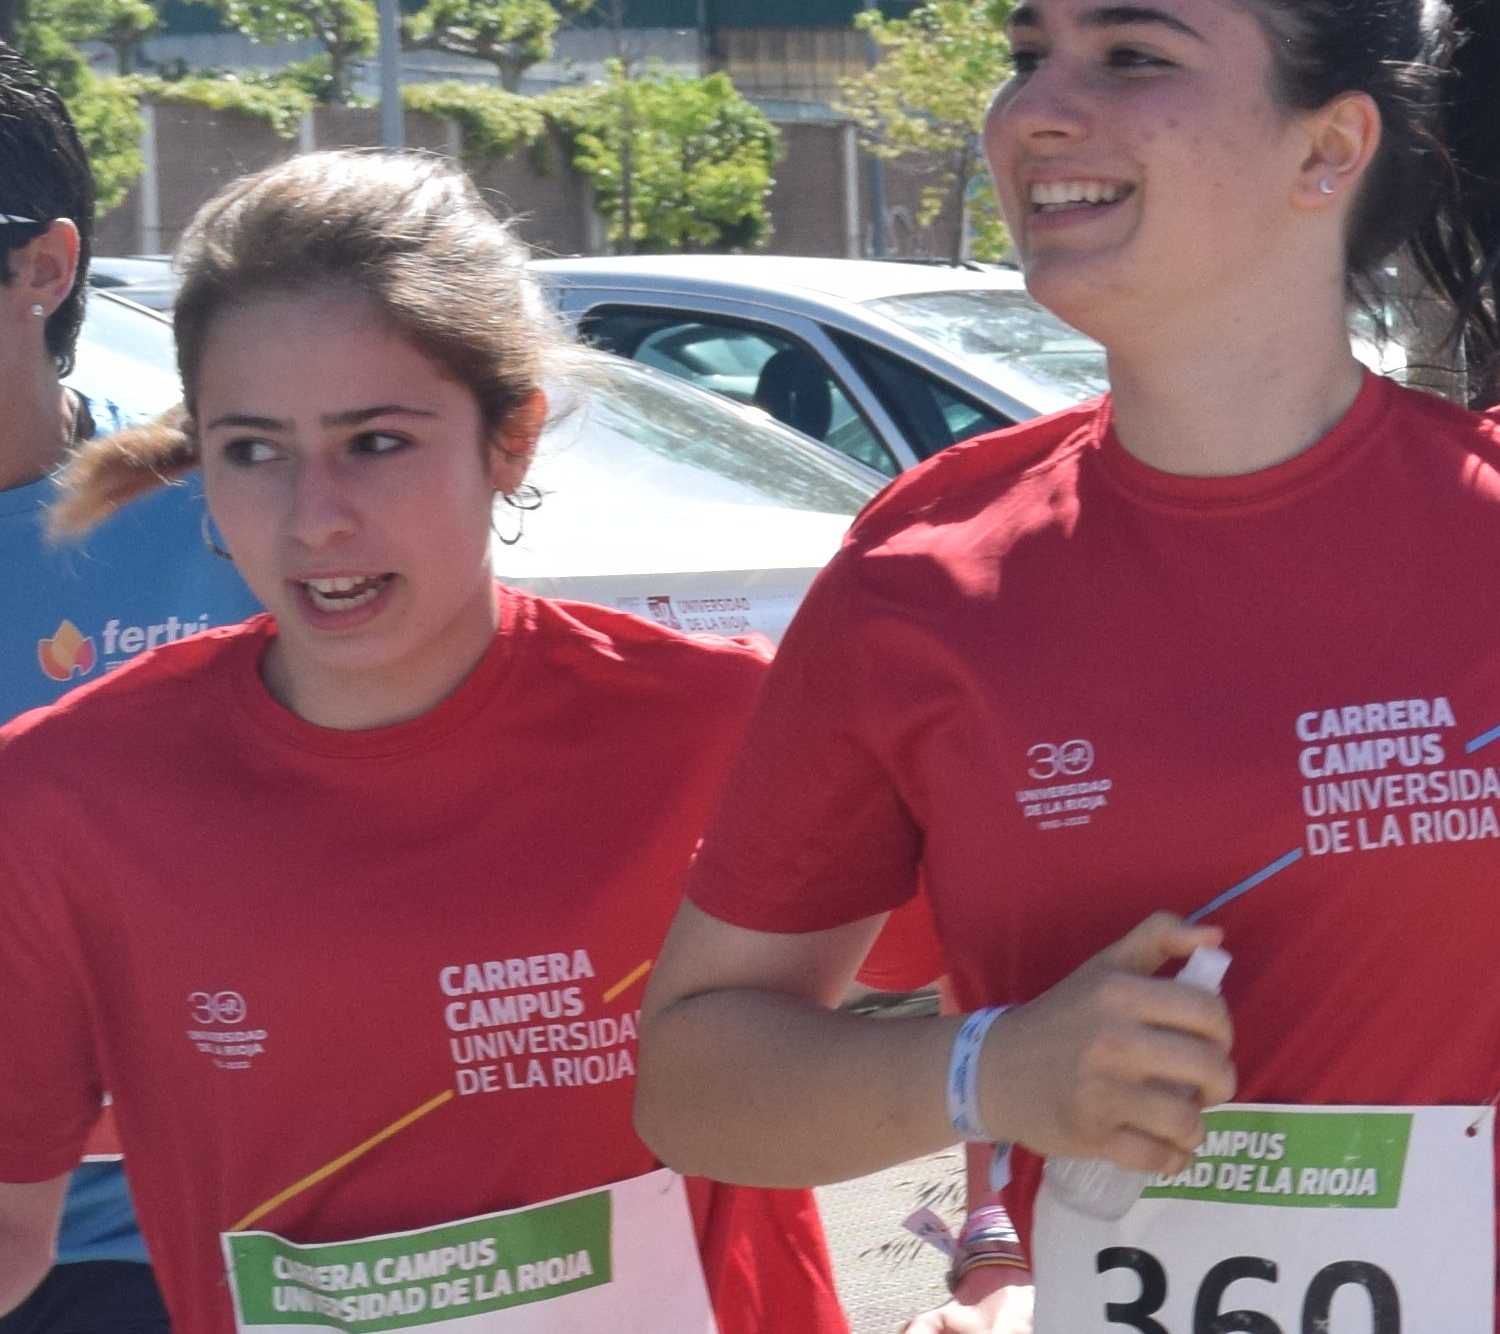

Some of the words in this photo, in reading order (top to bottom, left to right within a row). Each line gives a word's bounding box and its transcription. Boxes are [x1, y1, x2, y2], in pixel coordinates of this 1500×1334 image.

[677, 597, 750, 613] UNIVERSIDAD
[689, 616, 705, 631] DE
[706, 616, 720, 631] LA
[722, 614, 750, 631] RIOJA
[1295, 697, 1457, 742] CARRERA
[1298, 733, 1446, 779] CAMPUS
[1306, 820, 1353, 856] DE
[1357, 814, 1405, 850] LA
[1409, 806, 1500, 844] RIOJA
[439, 949, 595, 997] CARRERA
[445, 987, 585, 1031] CAMPUS
[450, 1009, 641, 1064] UNIVERSIDA
[456, 1068, 501, 1096] DE
[506, 1061, 548, 1090] LA
[553, 1049, 636, 1087] RIOJA
[1193, 1130, 1286, 1160] AMPUS
[1215, 1164, 1254, 1193] DE
[1256, 1167, 1293, 1195] LA
[1299, 1168, 1378, 1196] RIOJA
[374, 1237, 497, 1285] CAMPUS
[430, 1278, 470, 1310] DE
[475, 1269, 512, 1301] LA
[516, 1249, 594, 1292] RIOJA
